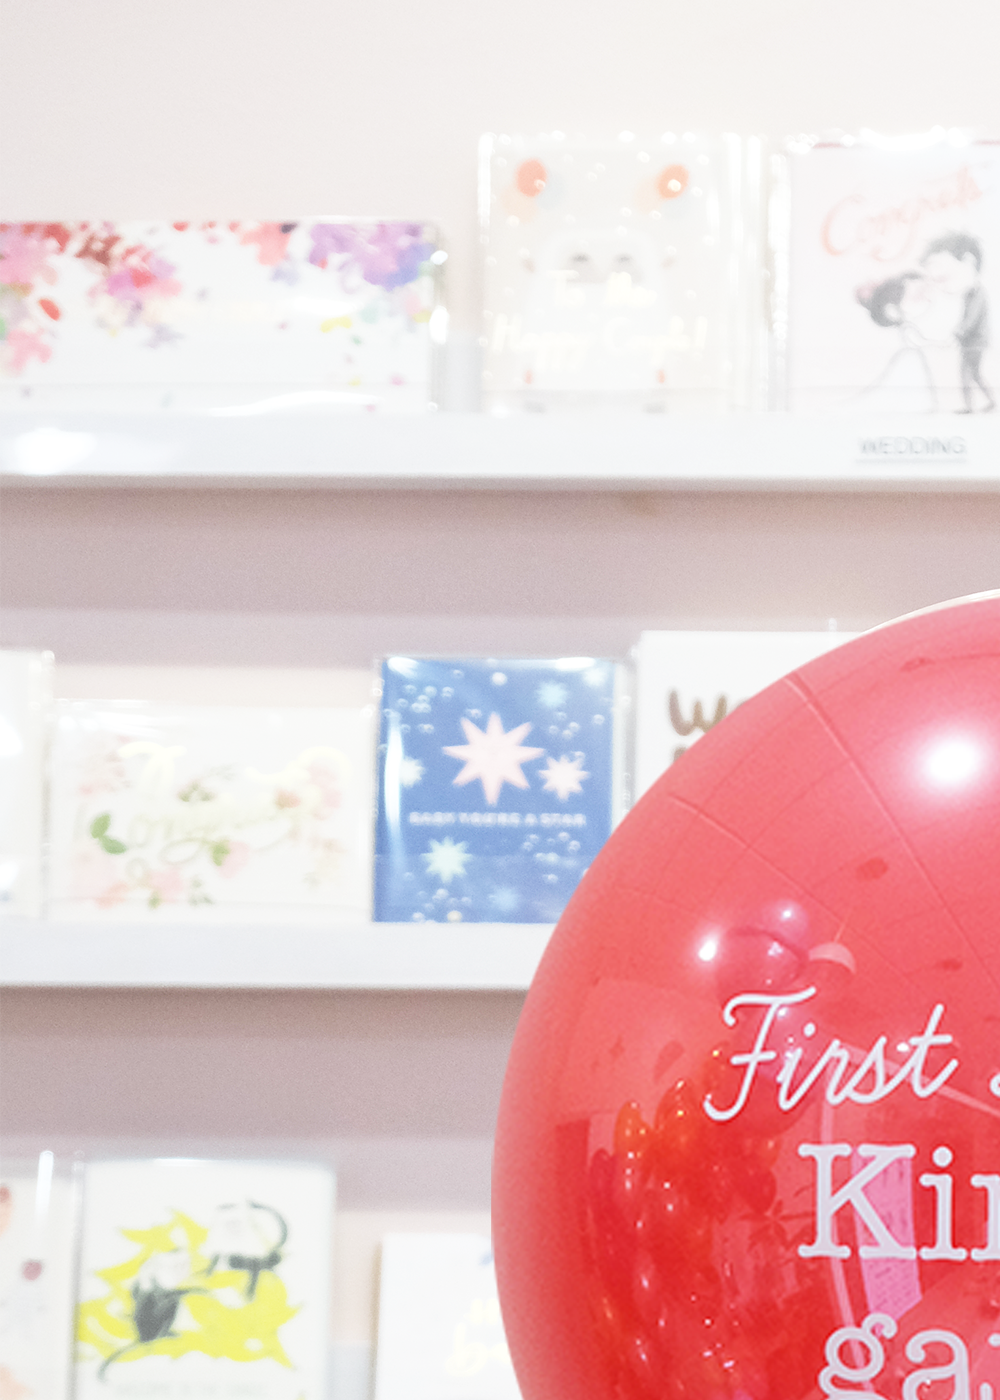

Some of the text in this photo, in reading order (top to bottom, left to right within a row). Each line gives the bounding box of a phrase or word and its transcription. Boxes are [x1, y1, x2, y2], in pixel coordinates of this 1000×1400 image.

[858, 436, 968, 454] WEDDING
[540, 812, 587, 828] STAR
[704, 986, 959, 1121] First
